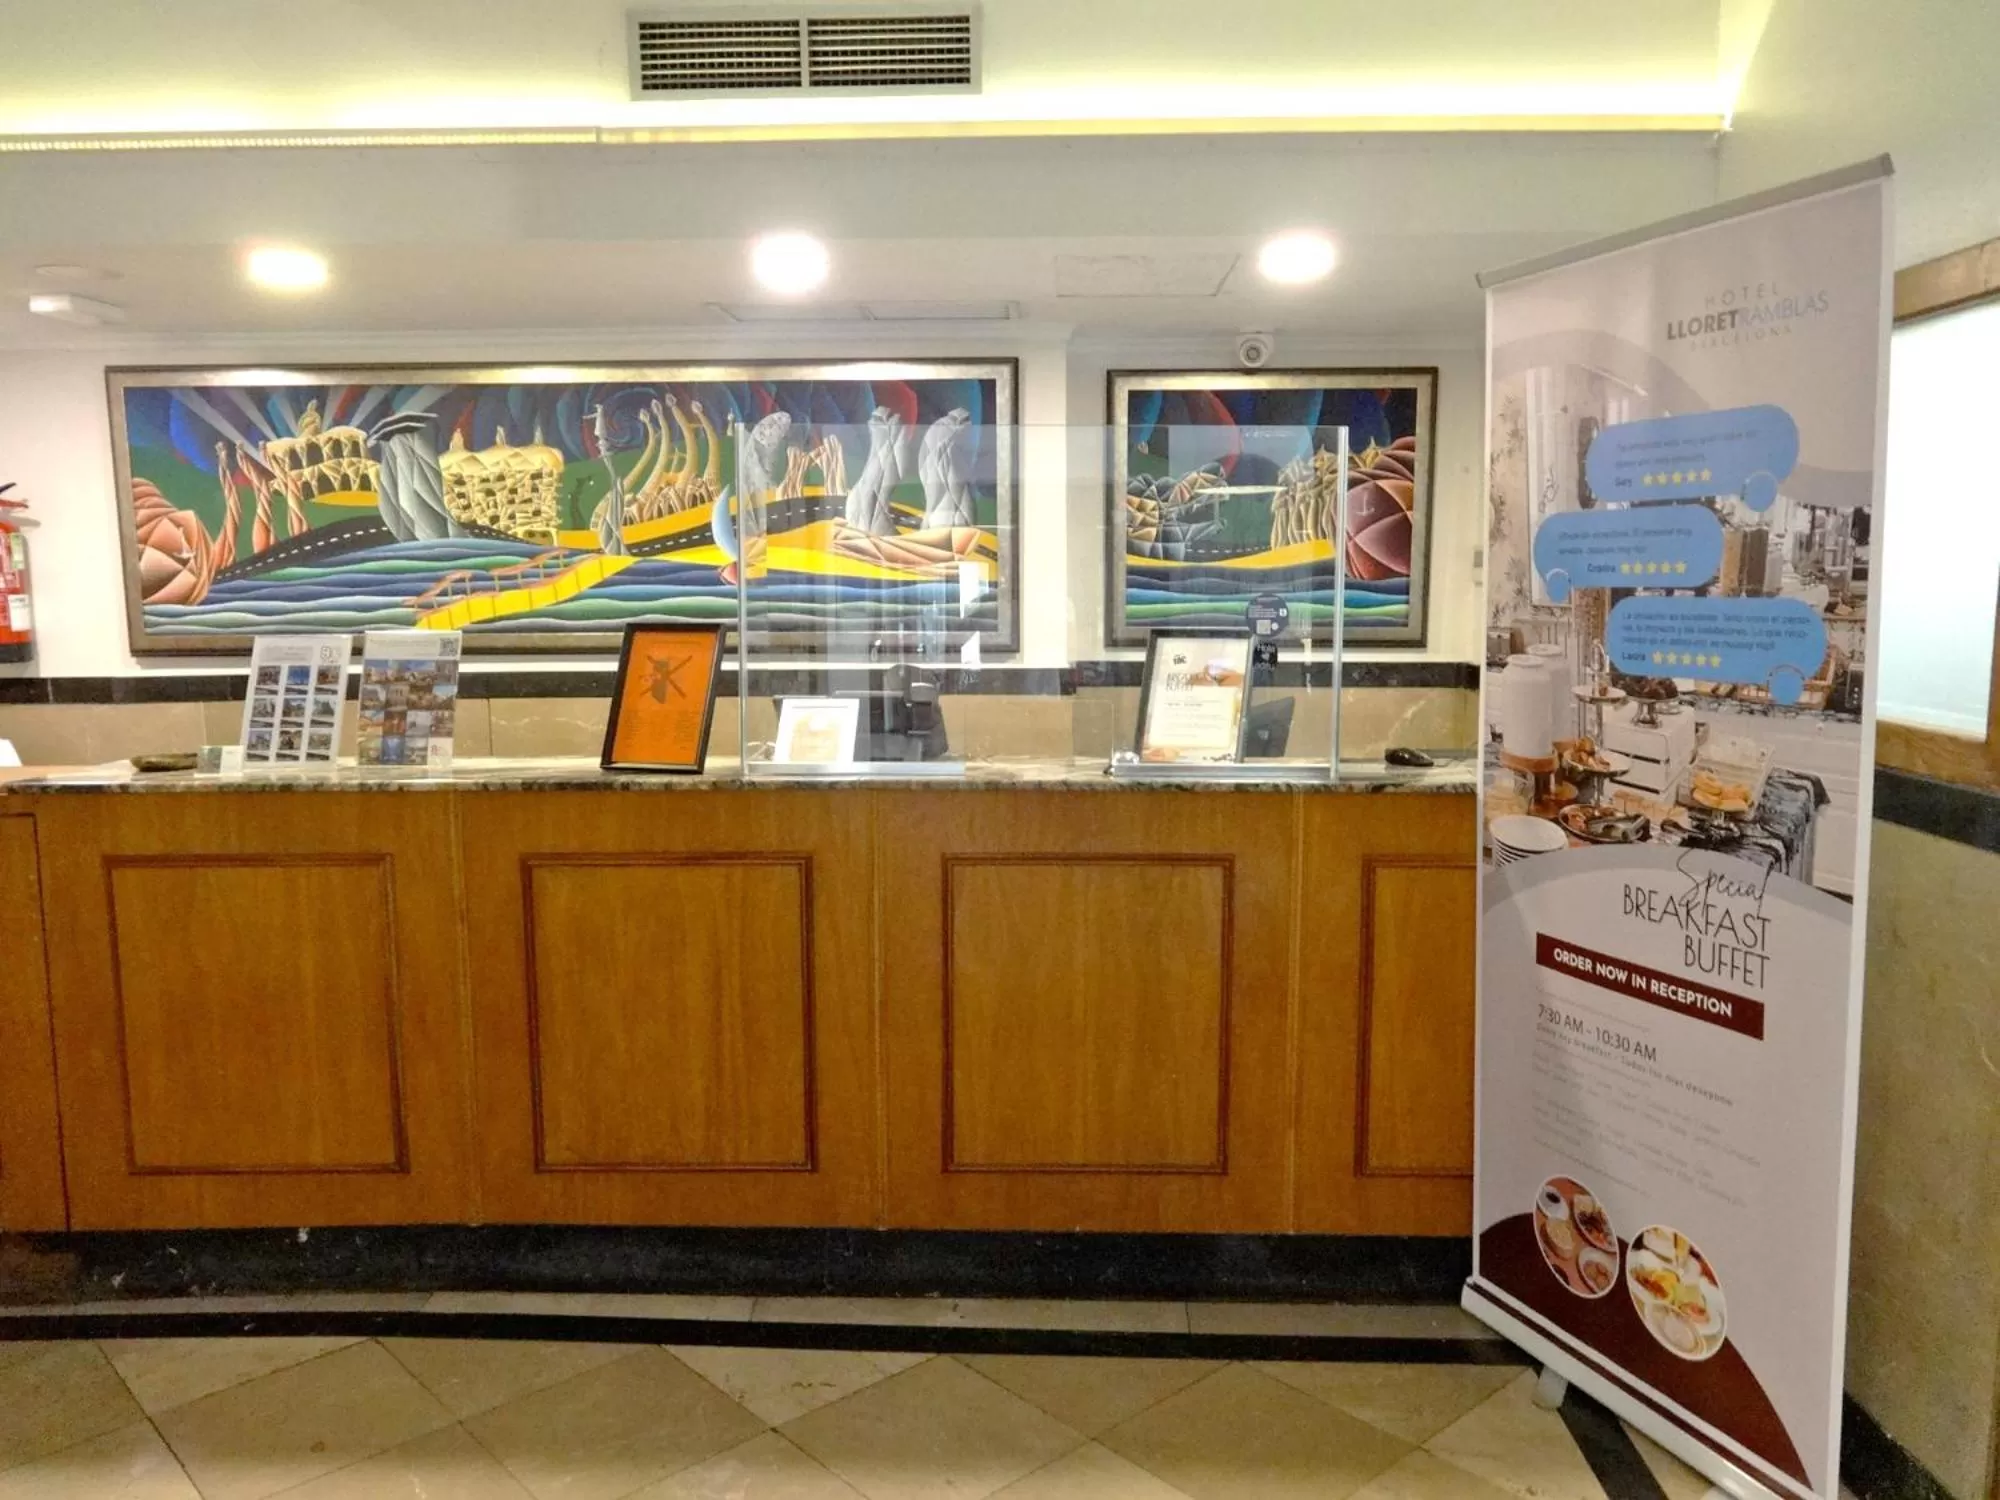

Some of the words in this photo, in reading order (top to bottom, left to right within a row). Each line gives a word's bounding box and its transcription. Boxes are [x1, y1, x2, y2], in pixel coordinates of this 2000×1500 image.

[1705, 282, 1778, 309] HOTEL
[1676, 847, 1775, 921] Special
[1623, 883, 1771, 951] BREAKFAST
[1553, 947, 1592, 973] ORDER
[1596, 961, 1628, 985] NOW
[1631, 972, 1647, 991] IN
[1650, 979, 1732, 1018] RECEPTION
[1684, 934, 1771, 989] BUFFET
[1537, 1003, 1561, 1025] 7:30
[1564, 1017, 1584, 1035] AM
[1595, 1026, 1630, 1053] 10:30
[1634, 1041, 1657, 1062] AM
